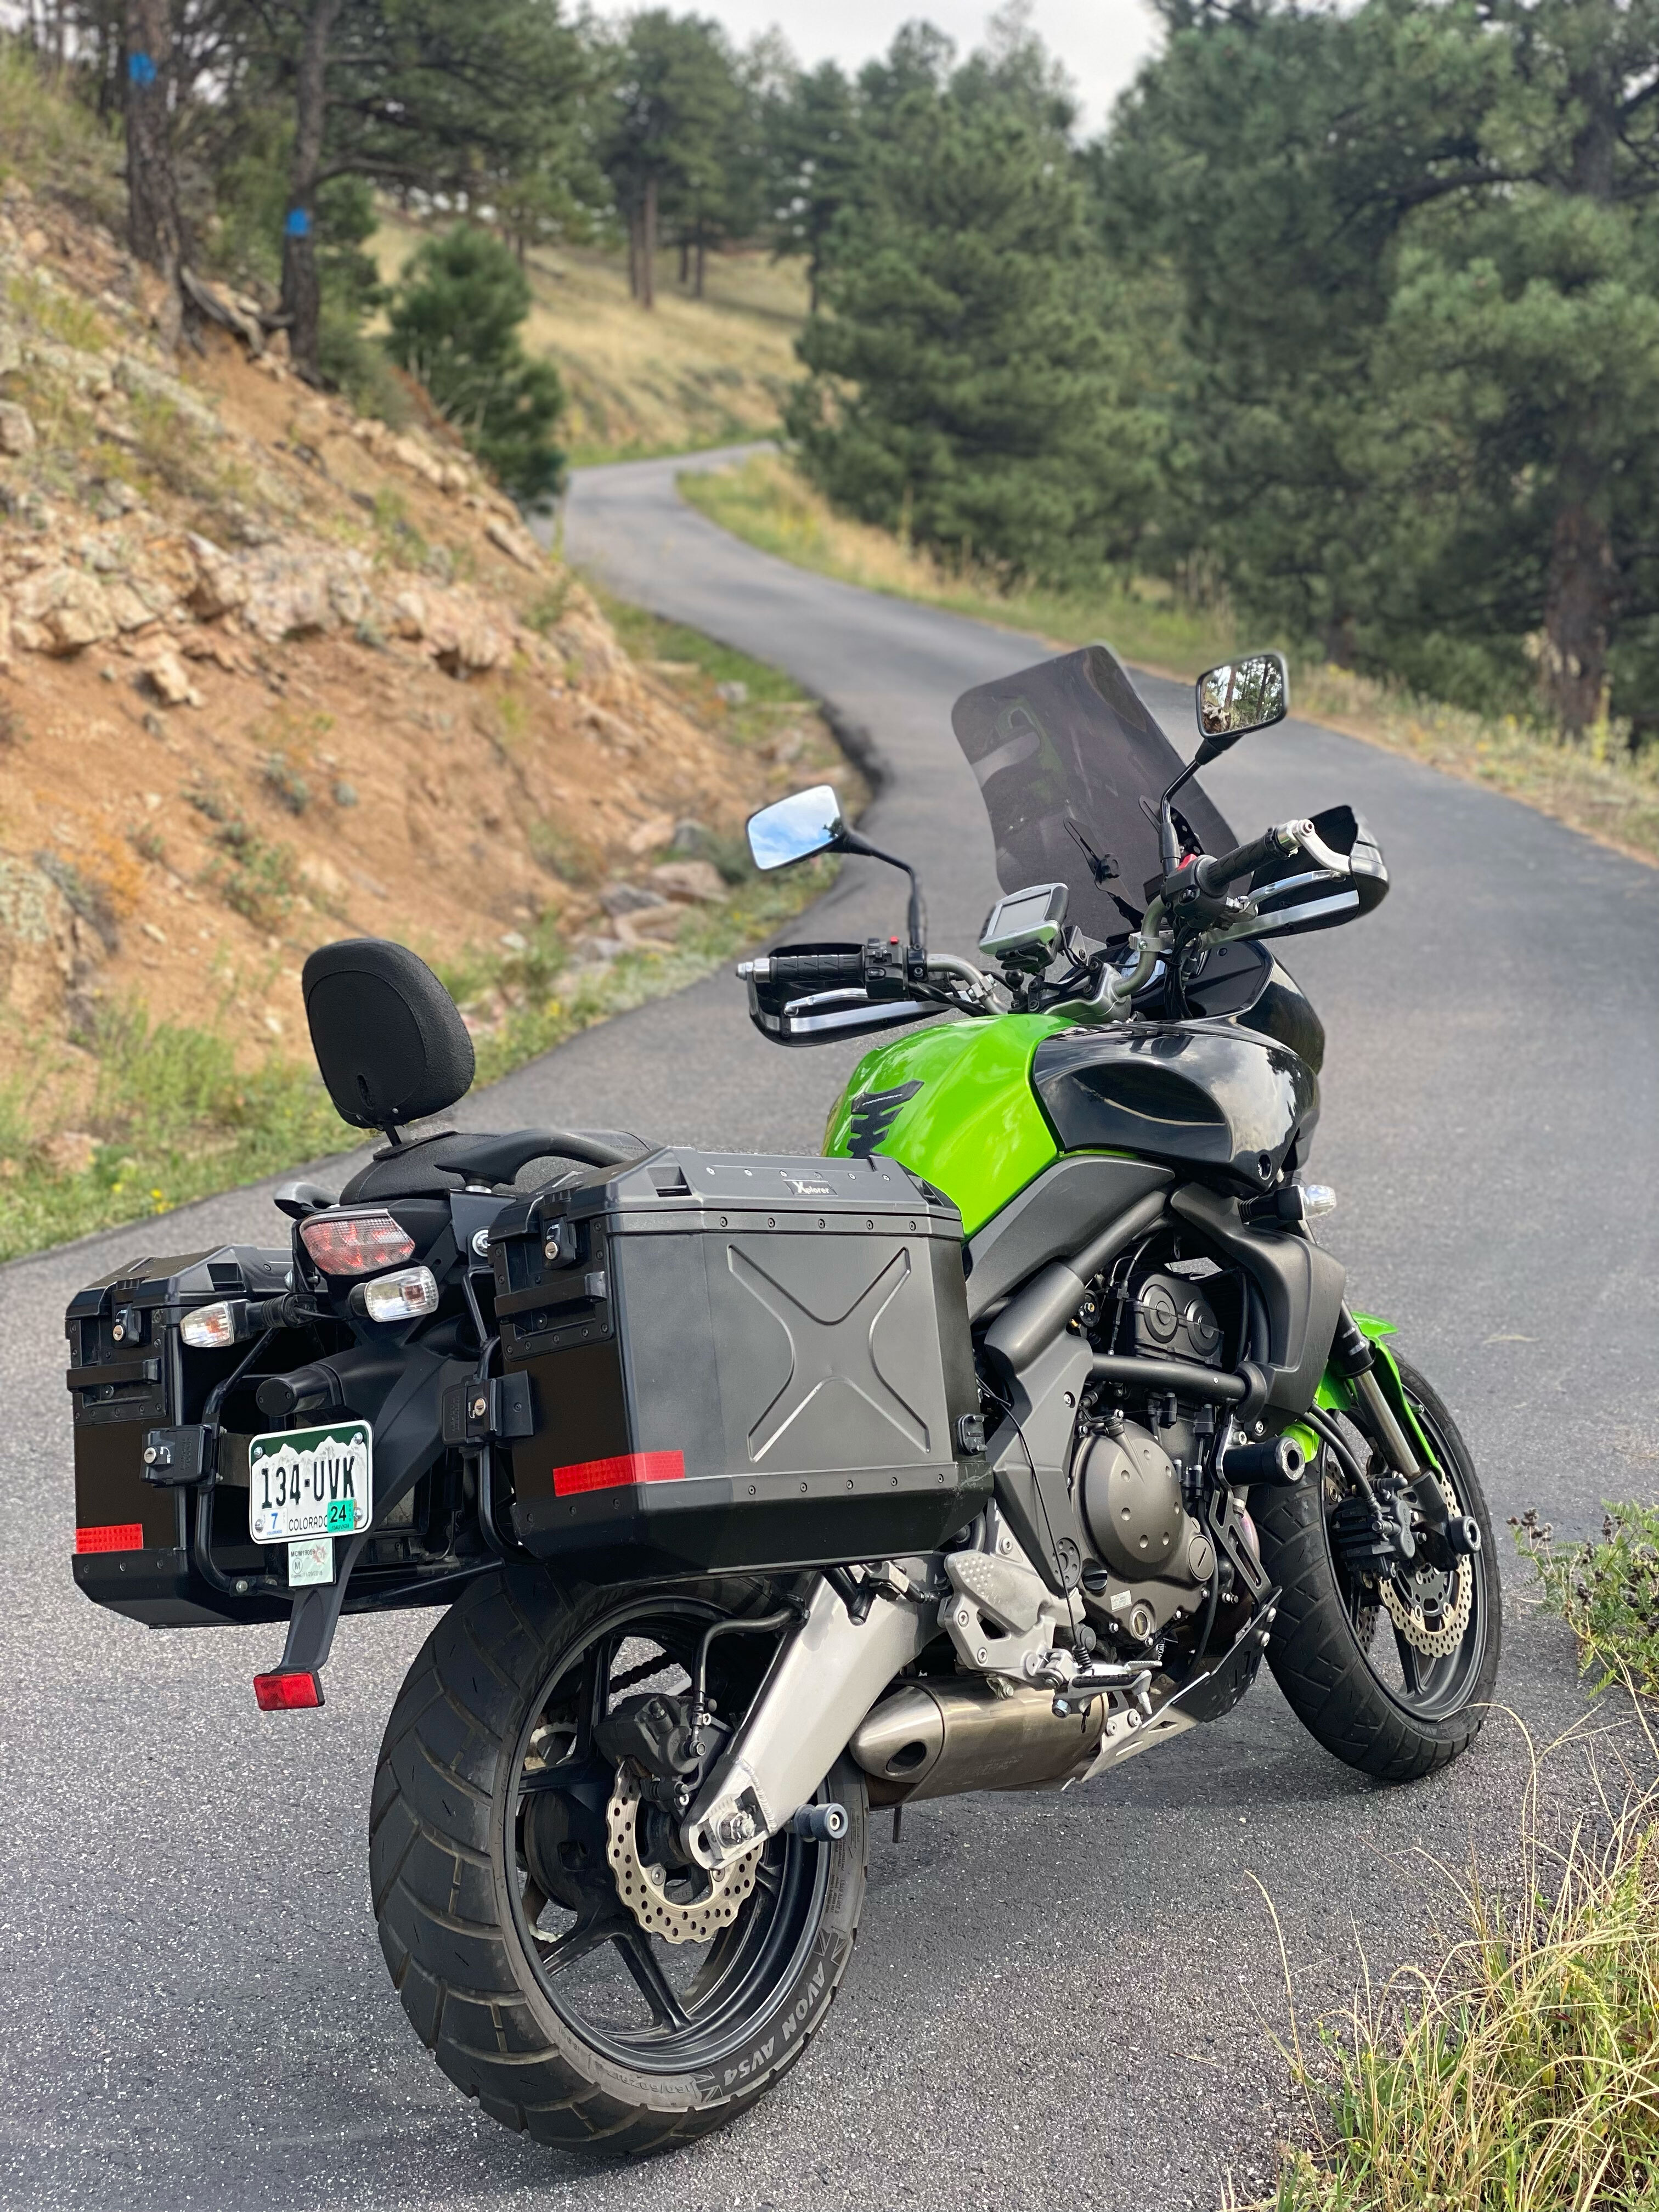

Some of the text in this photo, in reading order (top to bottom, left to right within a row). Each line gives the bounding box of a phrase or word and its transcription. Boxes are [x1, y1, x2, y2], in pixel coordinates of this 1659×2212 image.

[792, 1181, 830, 1195] Xplorer
[261, 1455, 355, 1509] 134-UVK
[270, 1513, 278, 1529] 7
[330, 1504, 347, 1523] 24
[724, 1960, 825, 2086] AVON AV54
